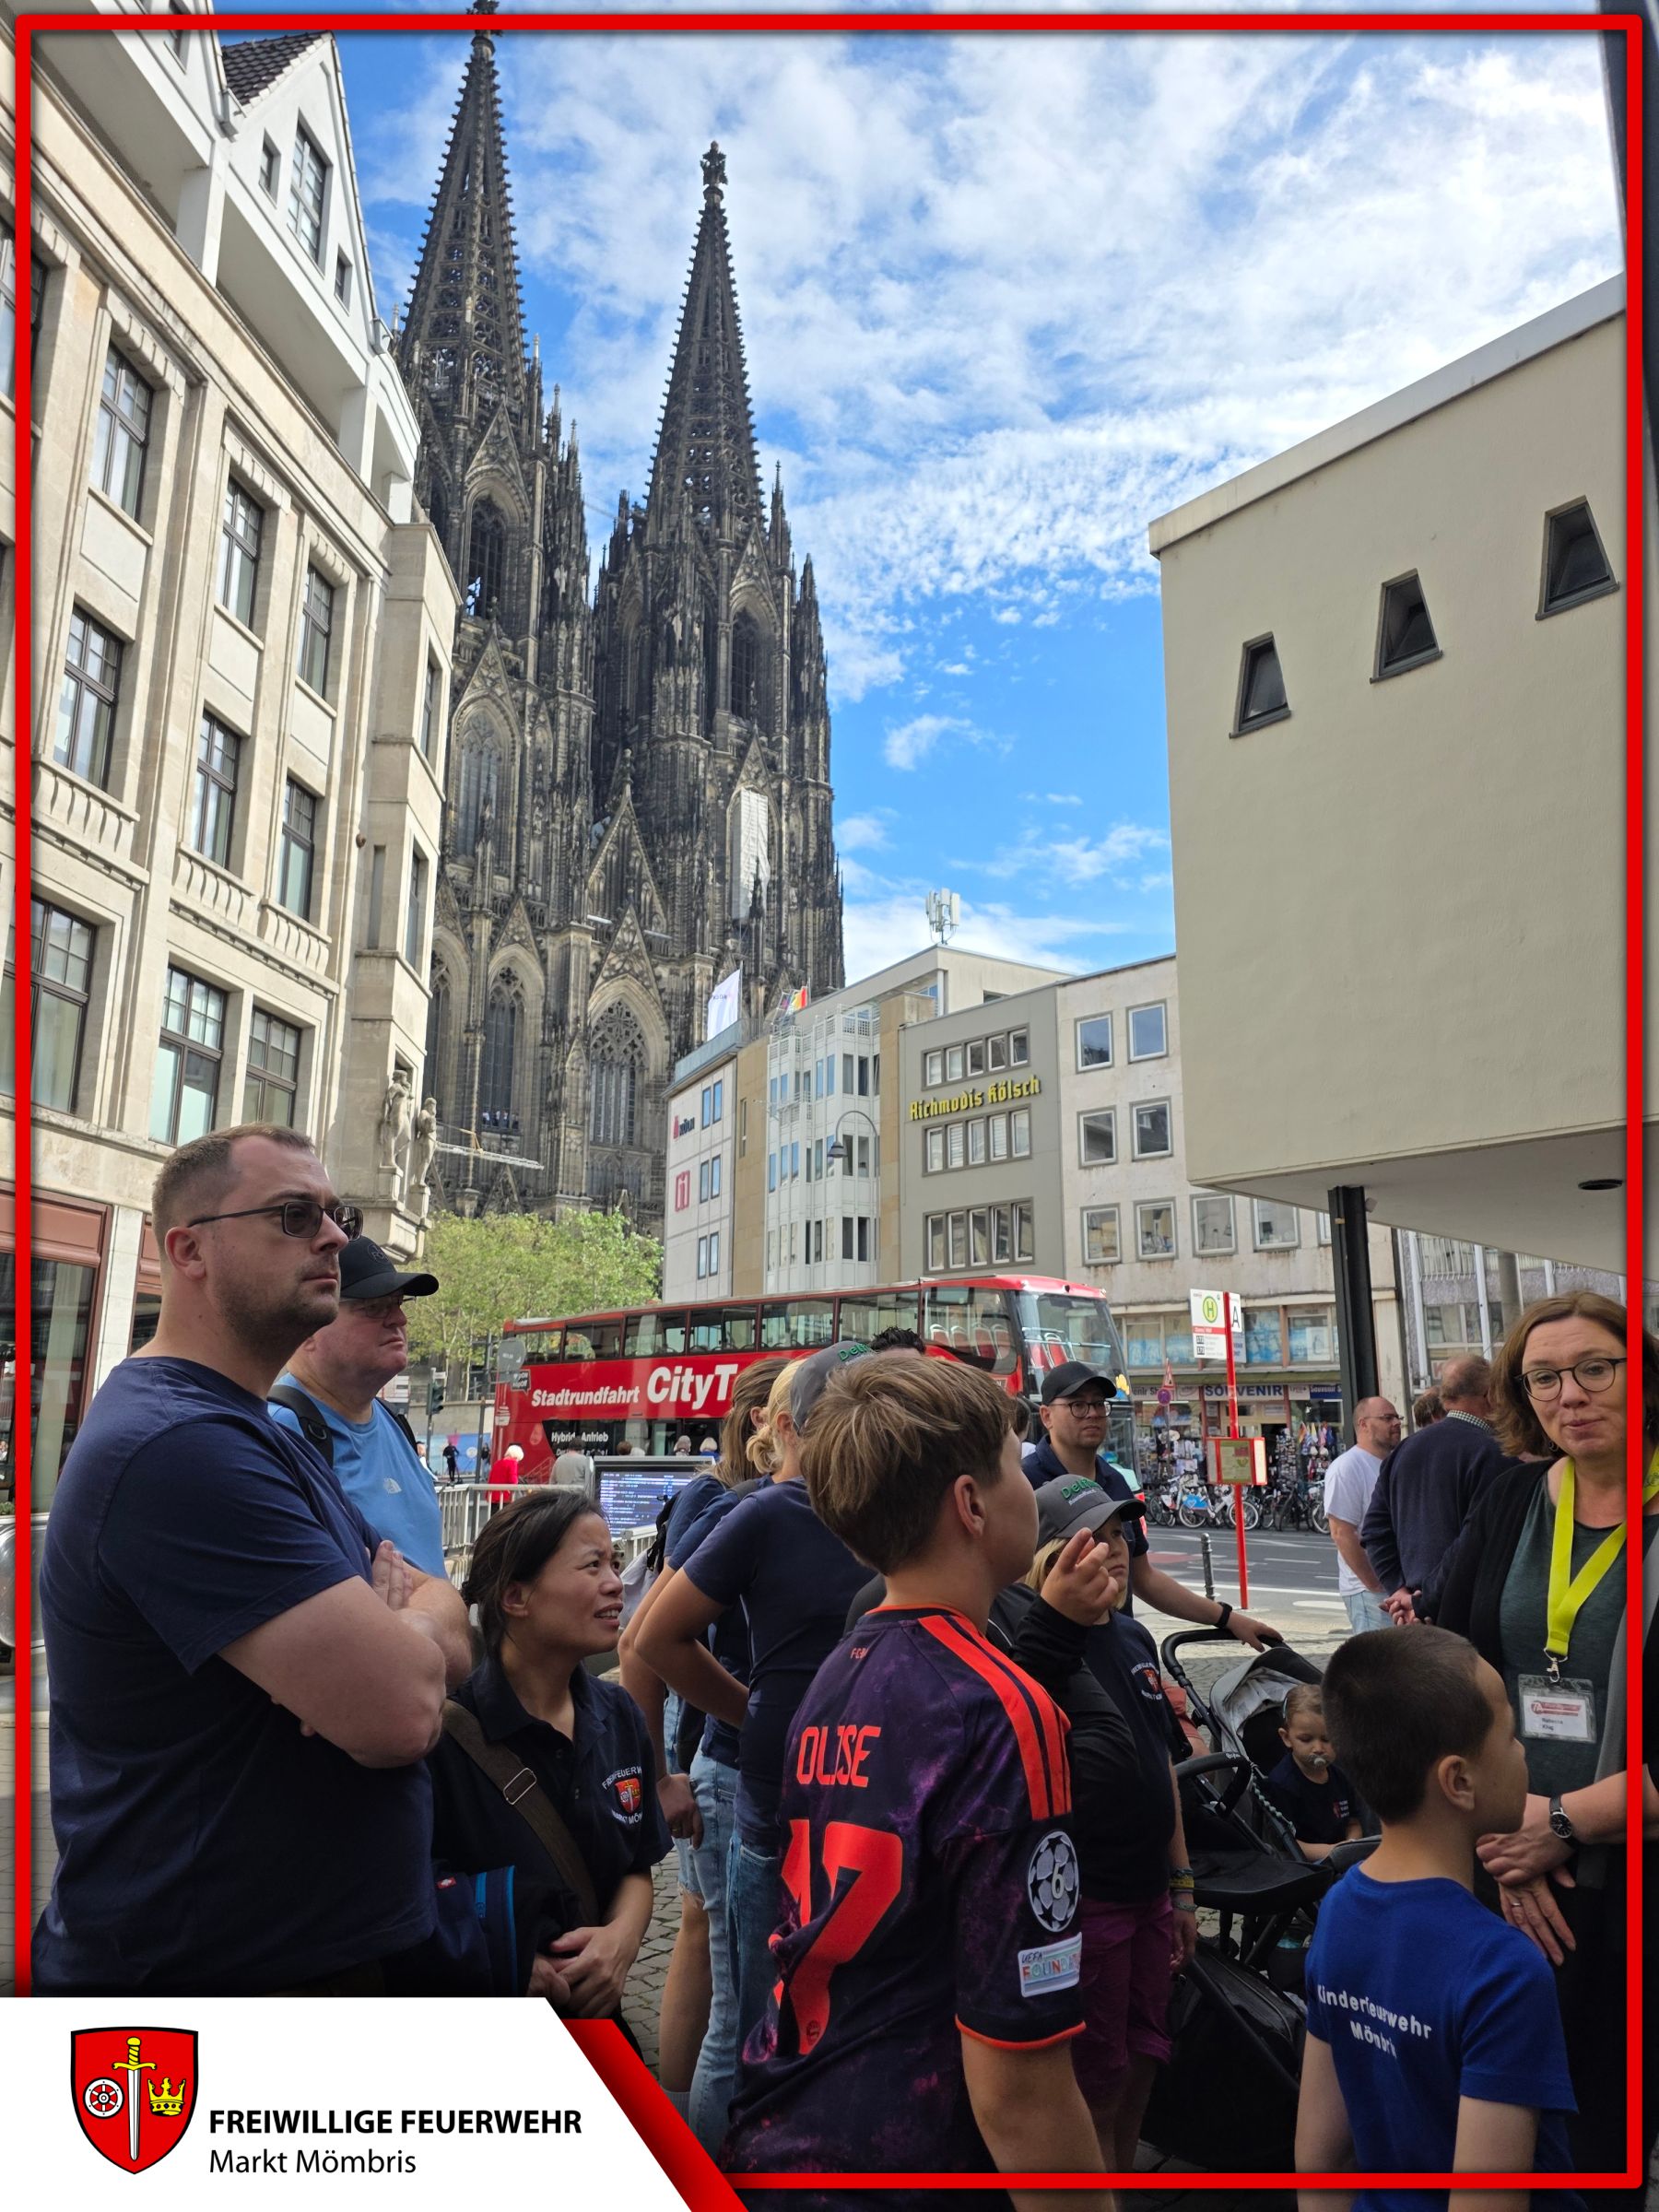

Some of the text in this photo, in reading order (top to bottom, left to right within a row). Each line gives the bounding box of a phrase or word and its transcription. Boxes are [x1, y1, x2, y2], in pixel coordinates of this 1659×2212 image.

[909, 1075, 1040, 1121] Richmodis Kölsch
[1231, 1305, 1241, 1328] A
[532, 1363, 739, 1411] Stadtrundfahrt CityT
[1052, 1862, 1065, 1900] 6
[1021, 1951, 1042, 1963] UEFA
